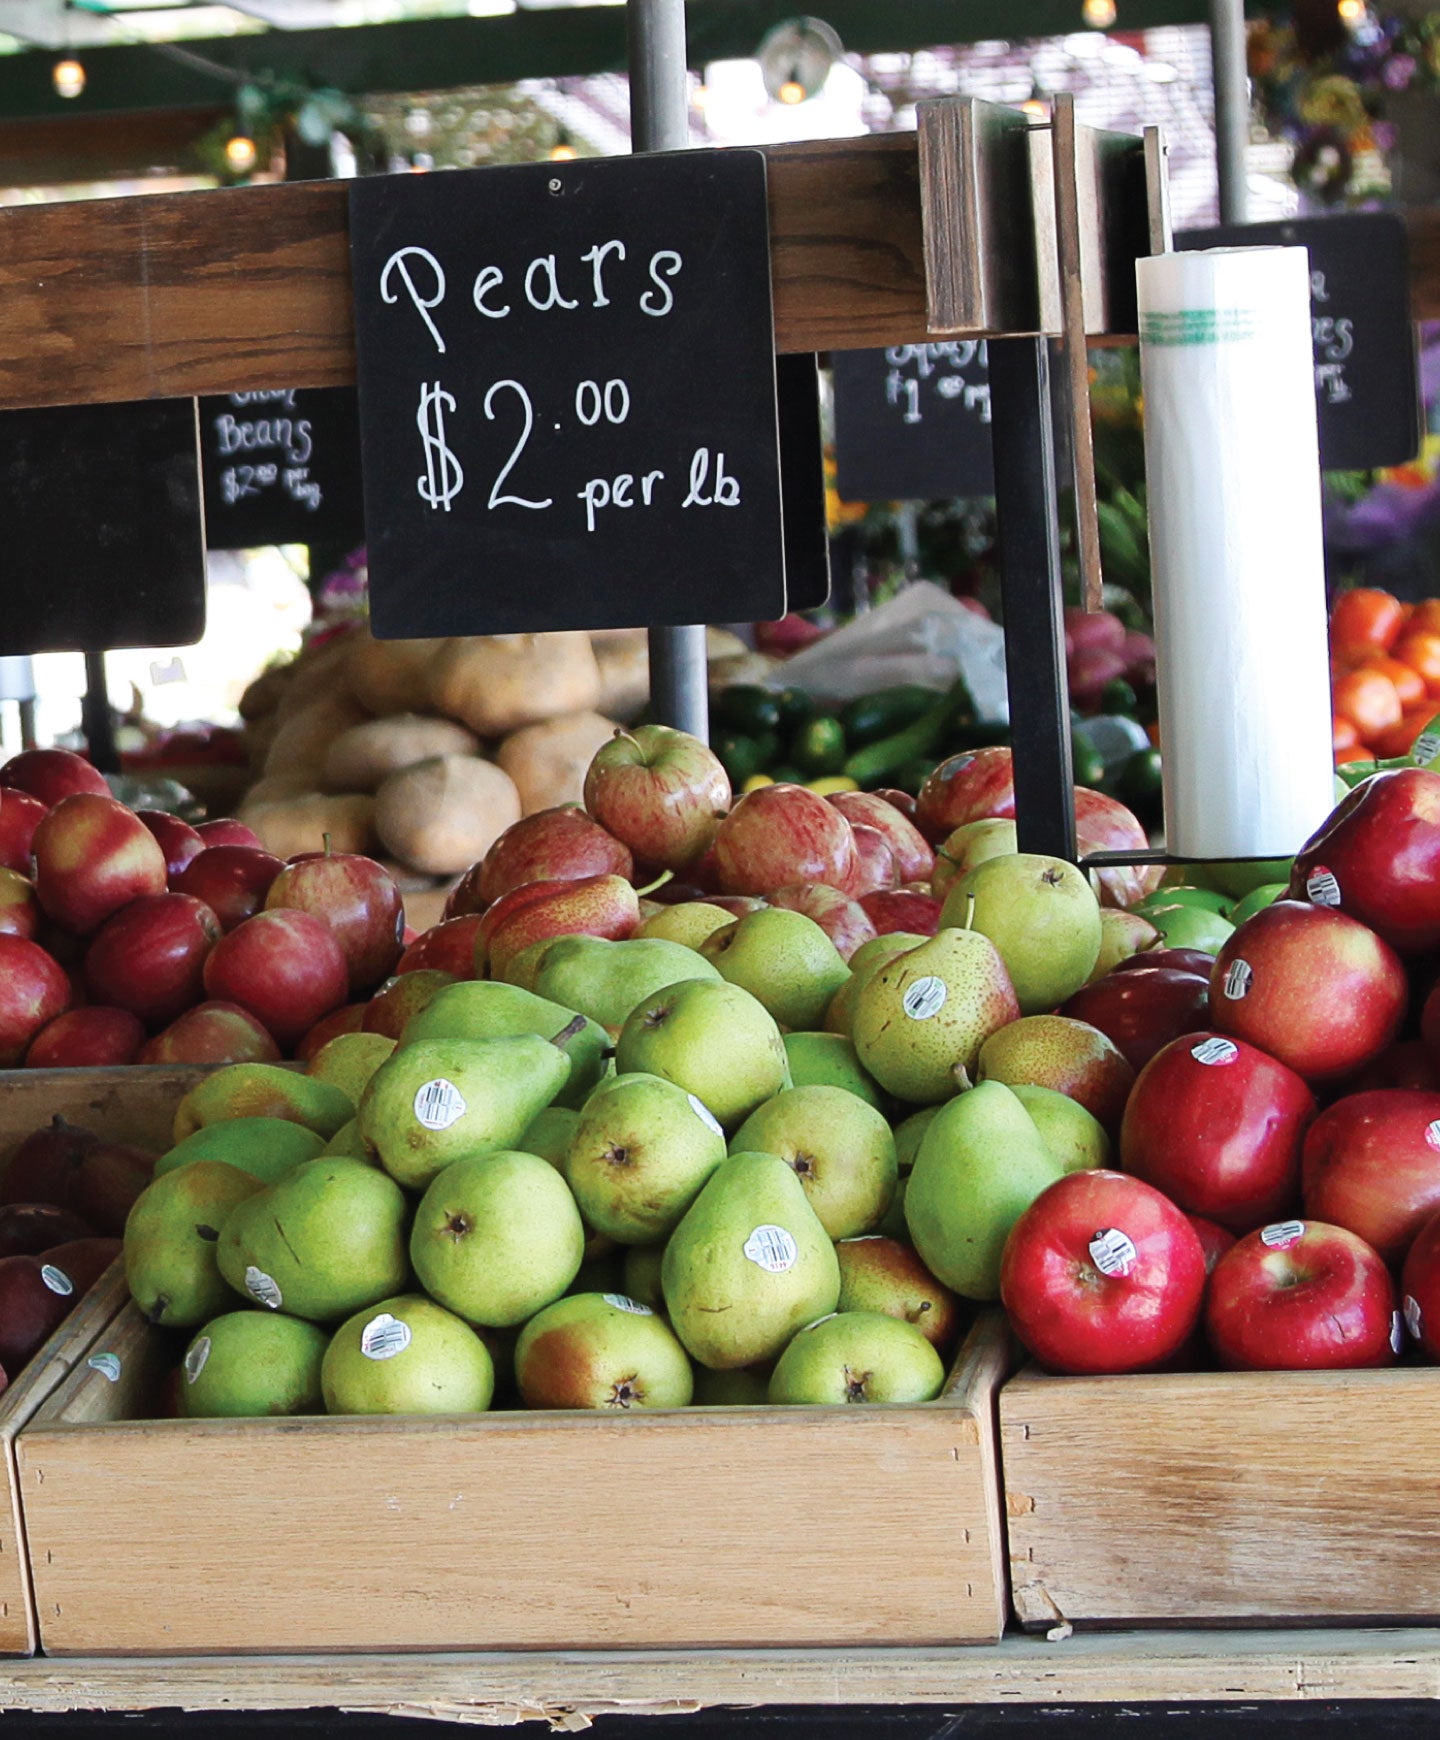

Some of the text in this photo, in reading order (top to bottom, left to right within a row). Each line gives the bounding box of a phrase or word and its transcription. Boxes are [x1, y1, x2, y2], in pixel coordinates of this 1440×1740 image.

[380, 239, 684, 354] Pears
[216, 413, 313, 464] Beans
[577, 469, 666, 532] per
[681, 447, 742, 508] lb
